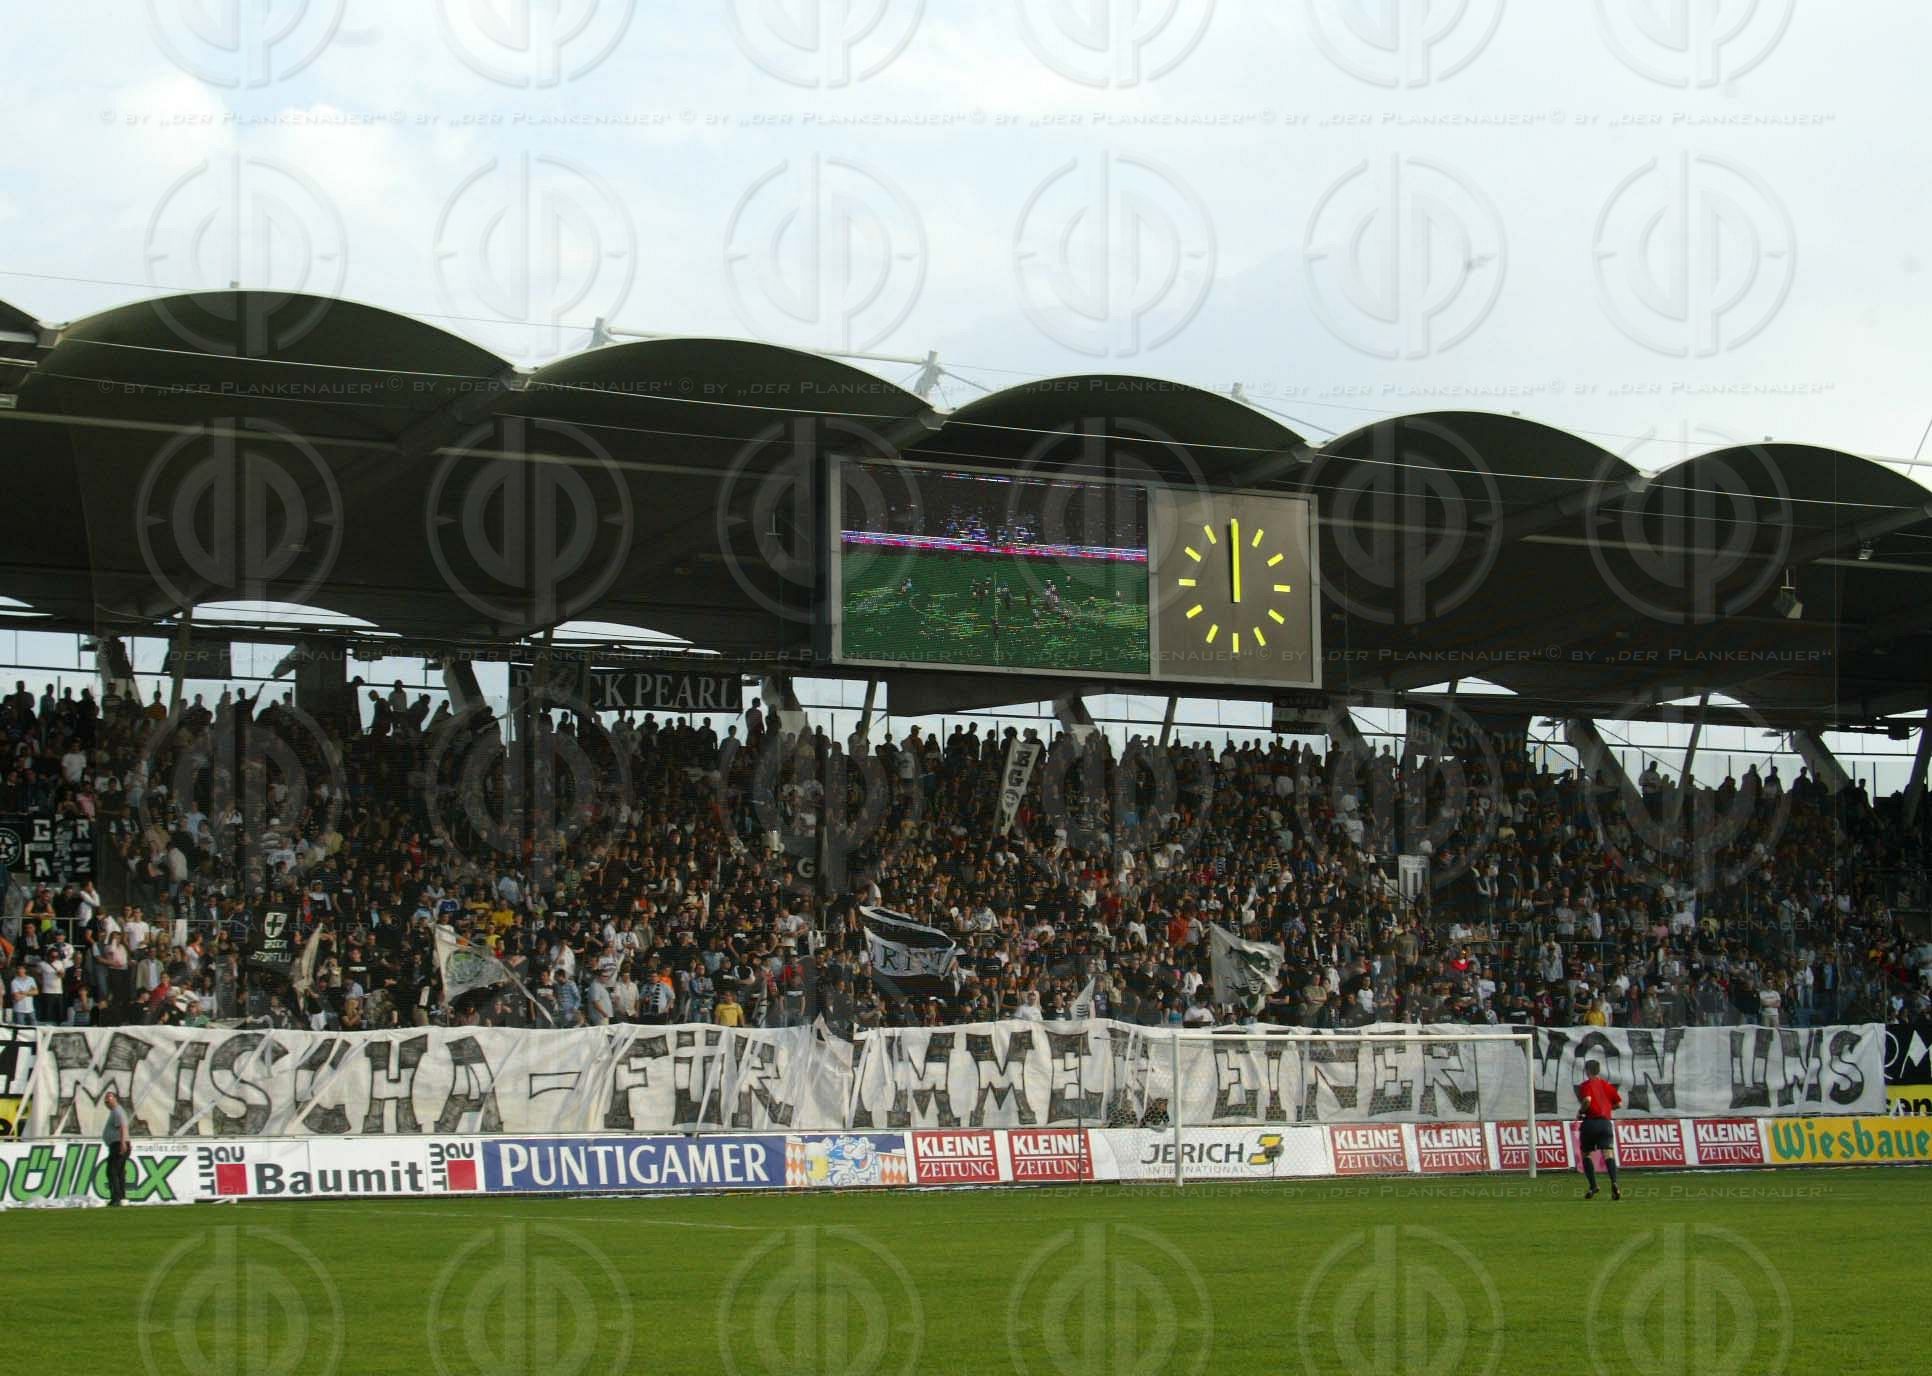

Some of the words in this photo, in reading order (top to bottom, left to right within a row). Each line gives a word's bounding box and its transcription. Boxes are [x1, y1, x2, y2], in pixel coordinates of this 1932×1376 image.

[633, 674, 738, 710] PEARL
[49, 1031, 504, 1136] MISCHA
[603, 1029, 794, 1129] FÜR
[1334, 1128, 1401, 1150] KLEINE
[1419, 1127, 1482, 1149] KLEINE
[1500, 1125, 1563, 1146] KLENE
[1619, 1124, 1681, 1143] KLEINE
[1698, 1123, 1756, 1142] KLEINE
[916, 1135, 993, 1157] KLEINE
[1012, 1134, 1087, 1156] KLEINE
[1621, 1147, 1683, 1162] ZEITUNG
[1701, 1145, 1761, 1161] ZEITUNG
[500, 1142, 769, 1187] PUNTIGAMER
[919, 1160, 995, 1178] ZEITUNG
[1016, 1159, 1090, 1177] ZEITUNG
[1143, 1165, 1244, 1174] INTENATIONAL
[1337, 1152, 1404, 1169] ZEITUNG
[1422, 1151, 1486, 1168] ZEITUNG
[255, 1160, 425, 1195] Baumit
